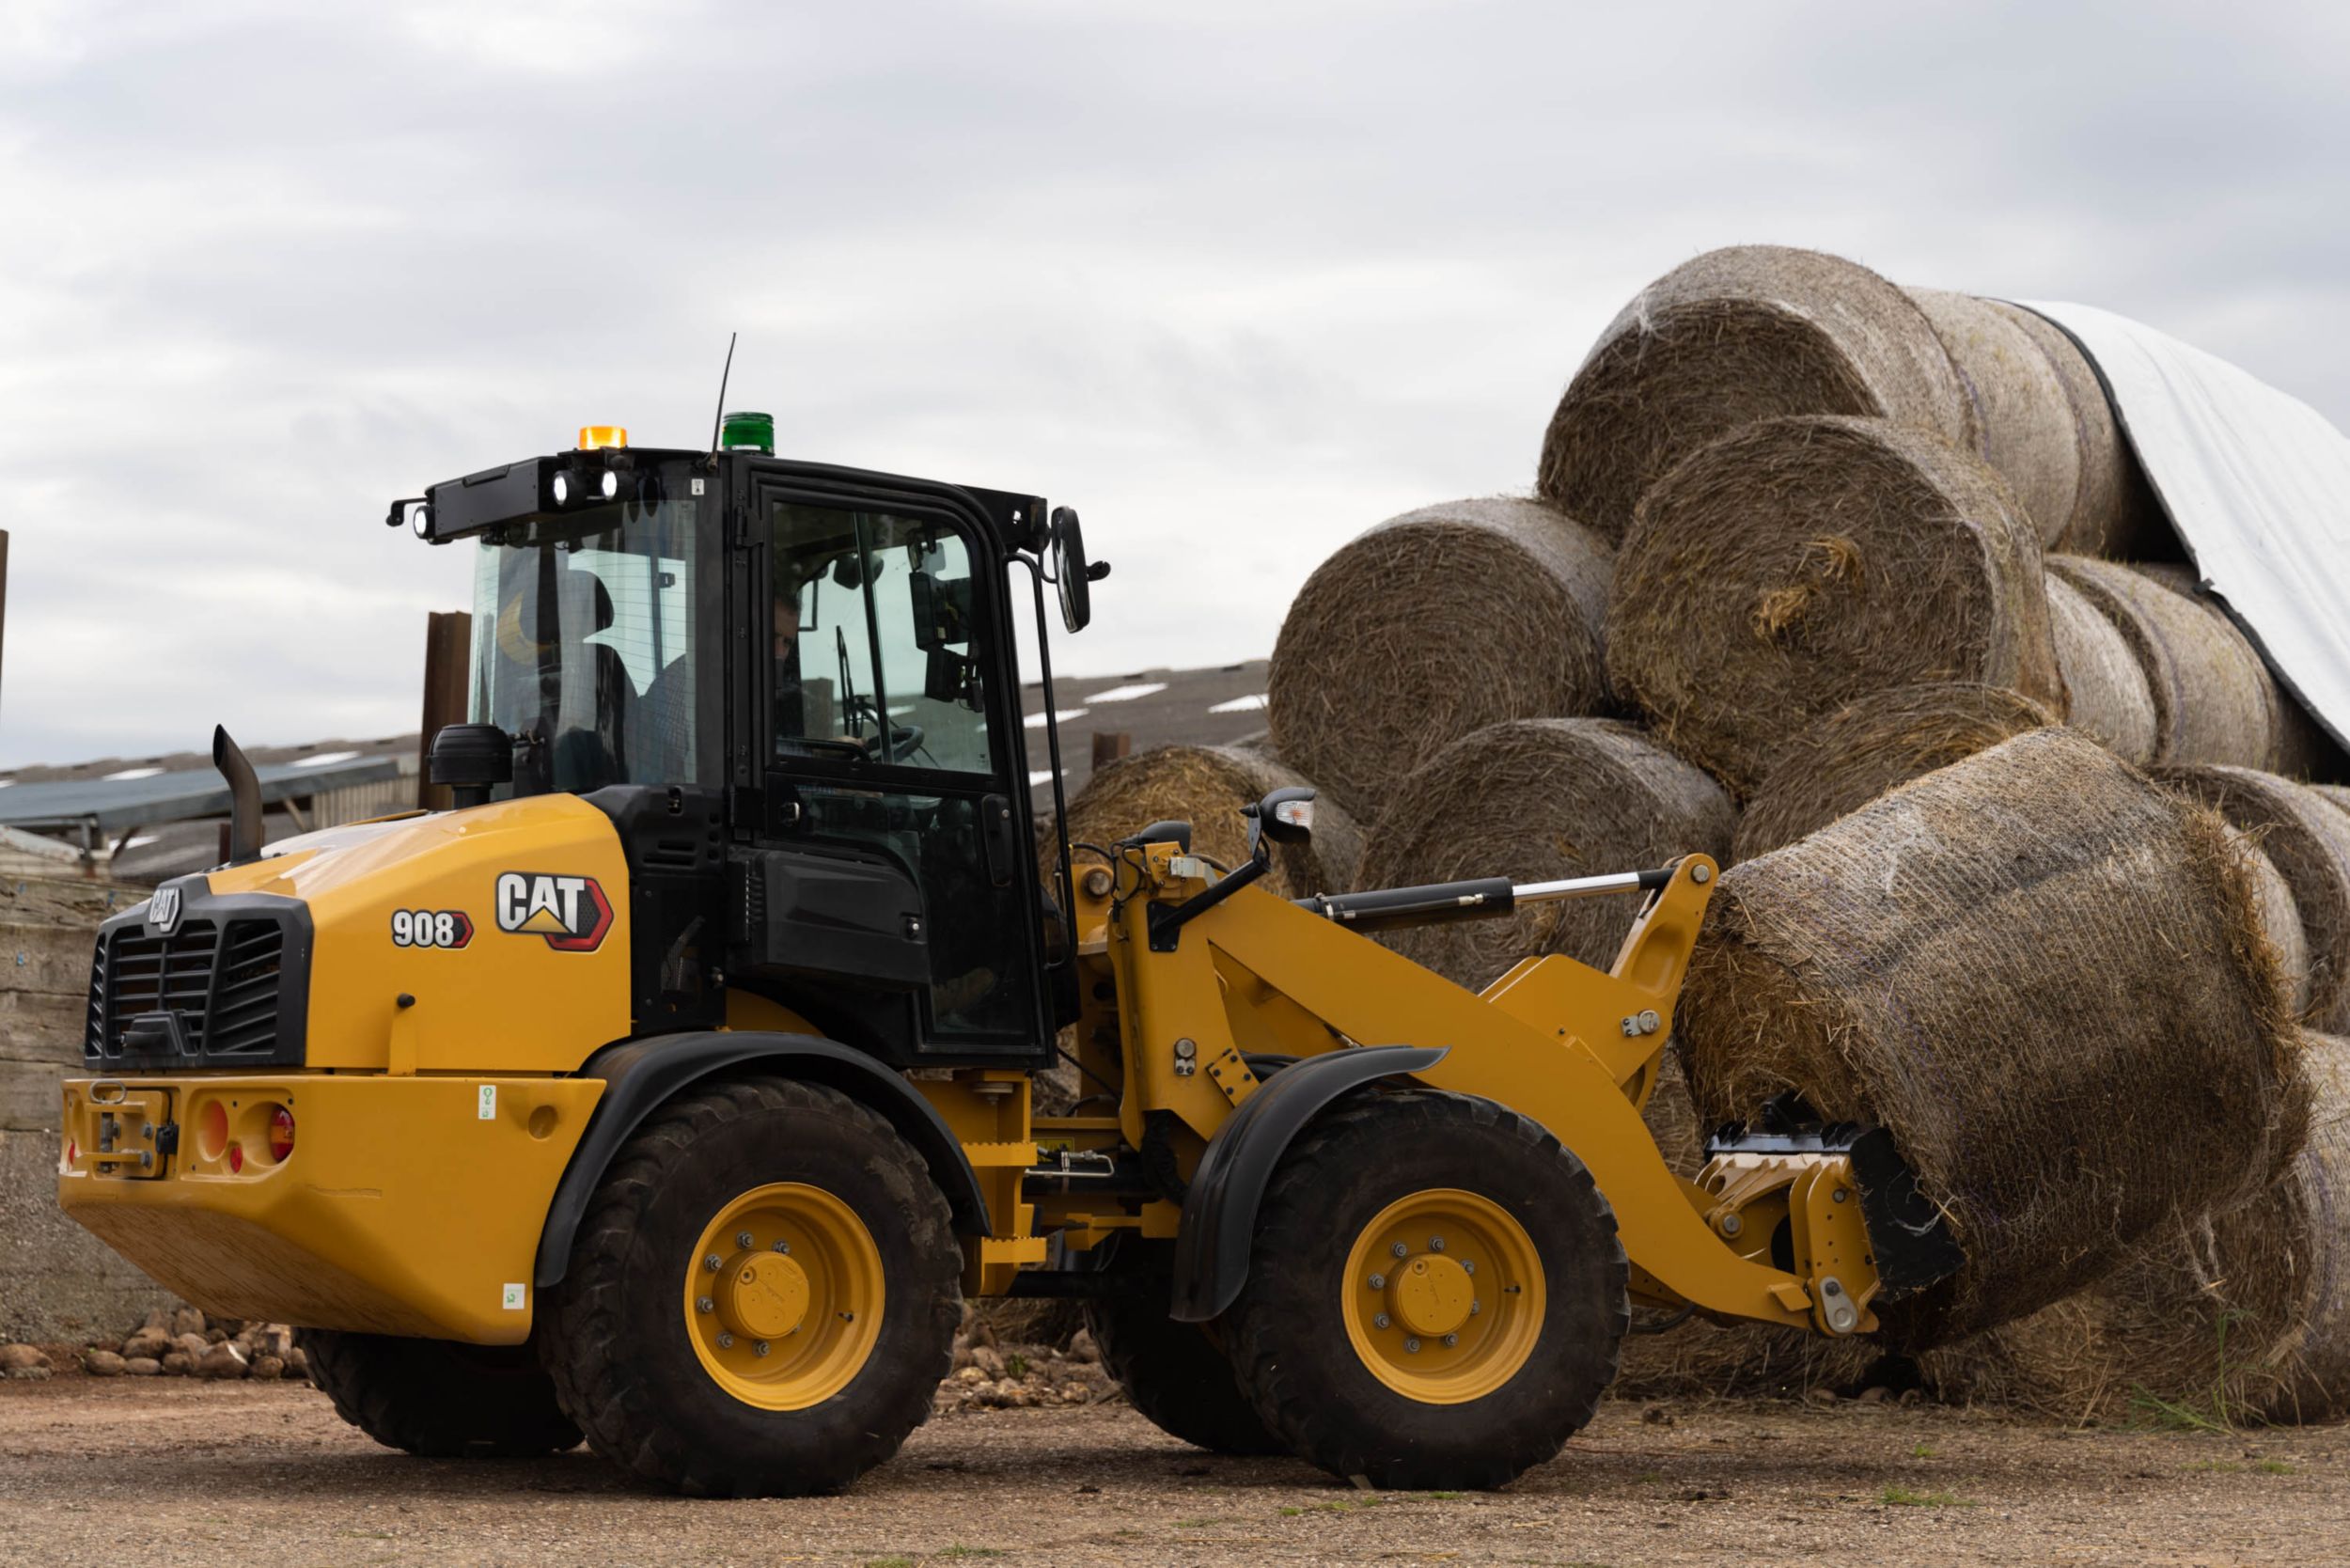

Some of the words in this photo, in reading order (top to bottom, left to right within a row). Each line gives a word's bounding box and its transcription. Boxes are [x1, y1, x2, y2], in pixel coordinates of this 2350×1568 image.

[149, 888, 175, 922] CAT
[498, 873, 585, 933] CAT
[393, 911, 454, 947] 908
